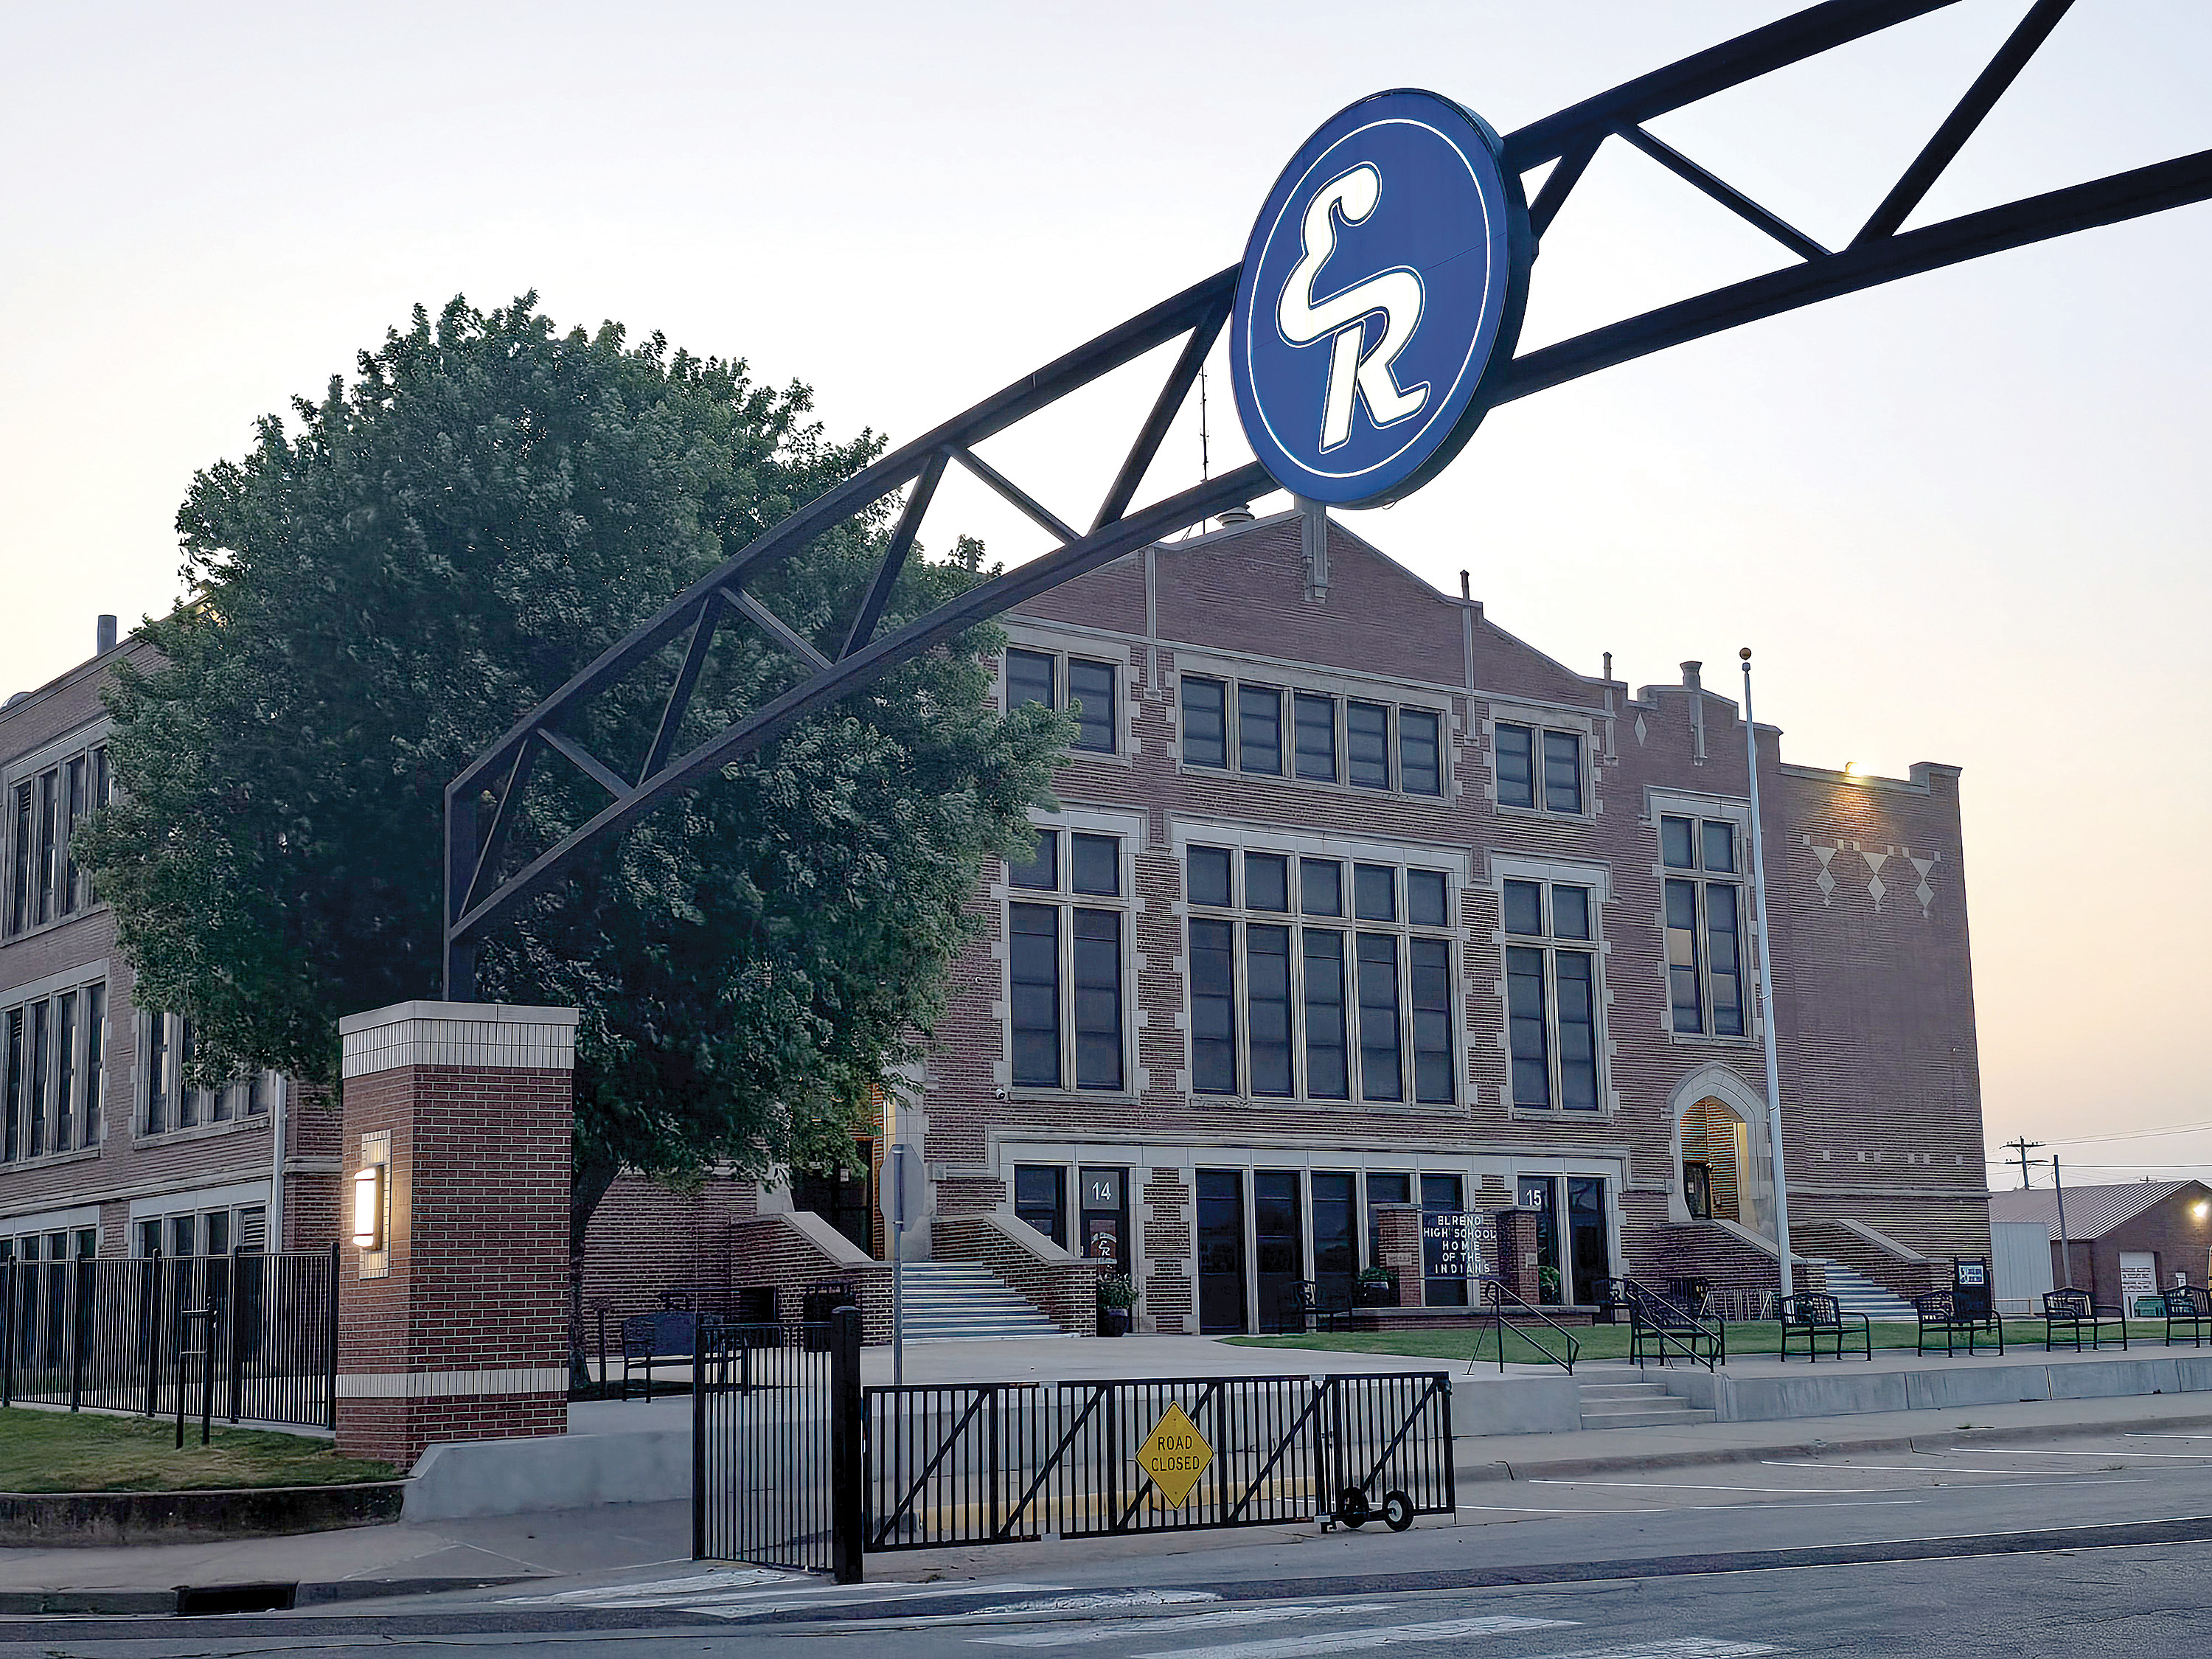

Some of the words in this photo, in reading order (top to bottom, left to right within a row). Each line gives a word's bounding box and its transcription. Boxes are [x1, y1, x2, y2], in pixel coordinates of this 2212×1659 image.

[1091, 1180, 1112, 1201] 14
[1526, 1189, 1542, 1206] 15
[1423, 1227, 1448, 1238] HIGH
[1454, 1228, 1497, 1239] SCHOOL
[1442, 1240, 1480, 1251] HOME
[1442, 1252, 1455, 1262] OF
[1460, 1252, 1481, 1262] THE
[1435, 1263, 1490, 1274] INDIANS
[1158, 1435, 1193, 1450] ROAD
[1151, 1455, 1200, 1472] CLOSED
